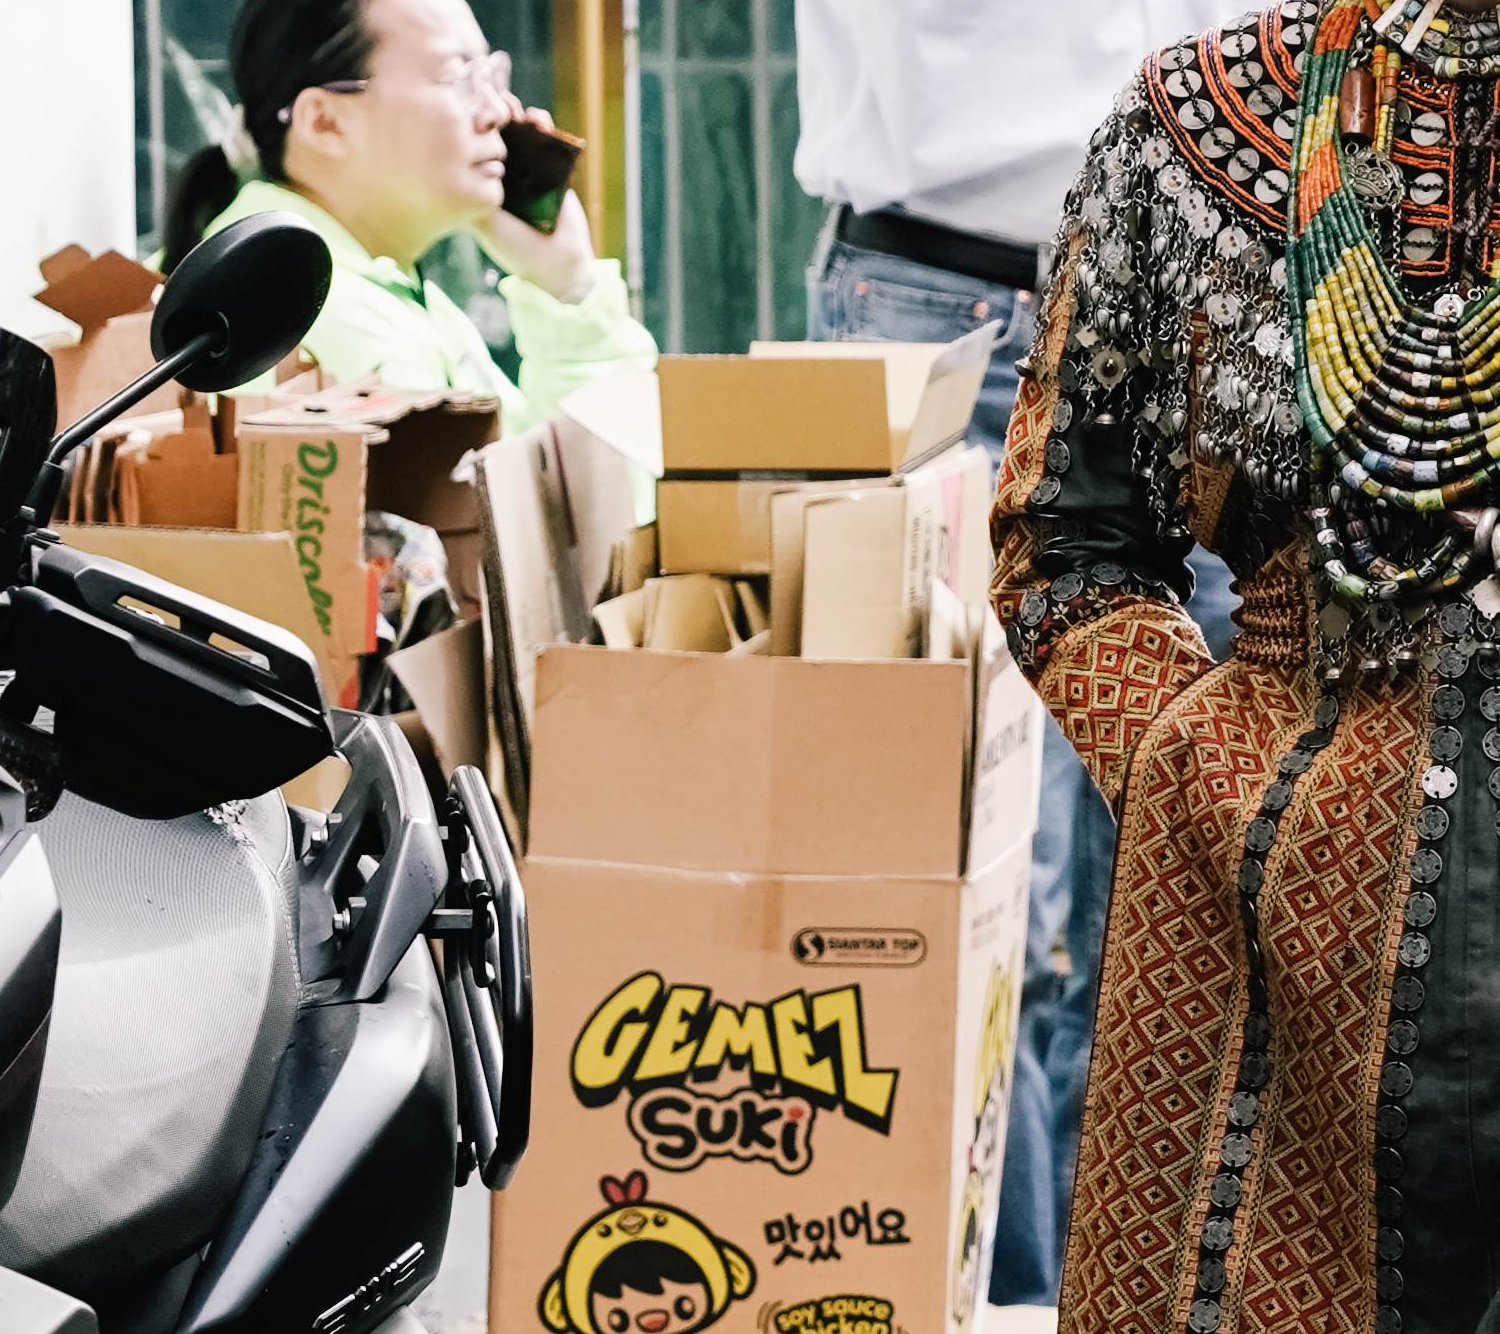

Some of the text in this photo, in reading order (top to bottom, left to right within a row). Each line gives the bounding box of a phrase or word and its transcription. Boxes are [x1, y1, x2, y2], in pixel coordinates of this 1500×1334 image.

[571, 970, 898, 1135] GEMEZ
[764, 1199, 911, 1266] 맛있어요
[776, 1298, 890, 1332] soy sauce
